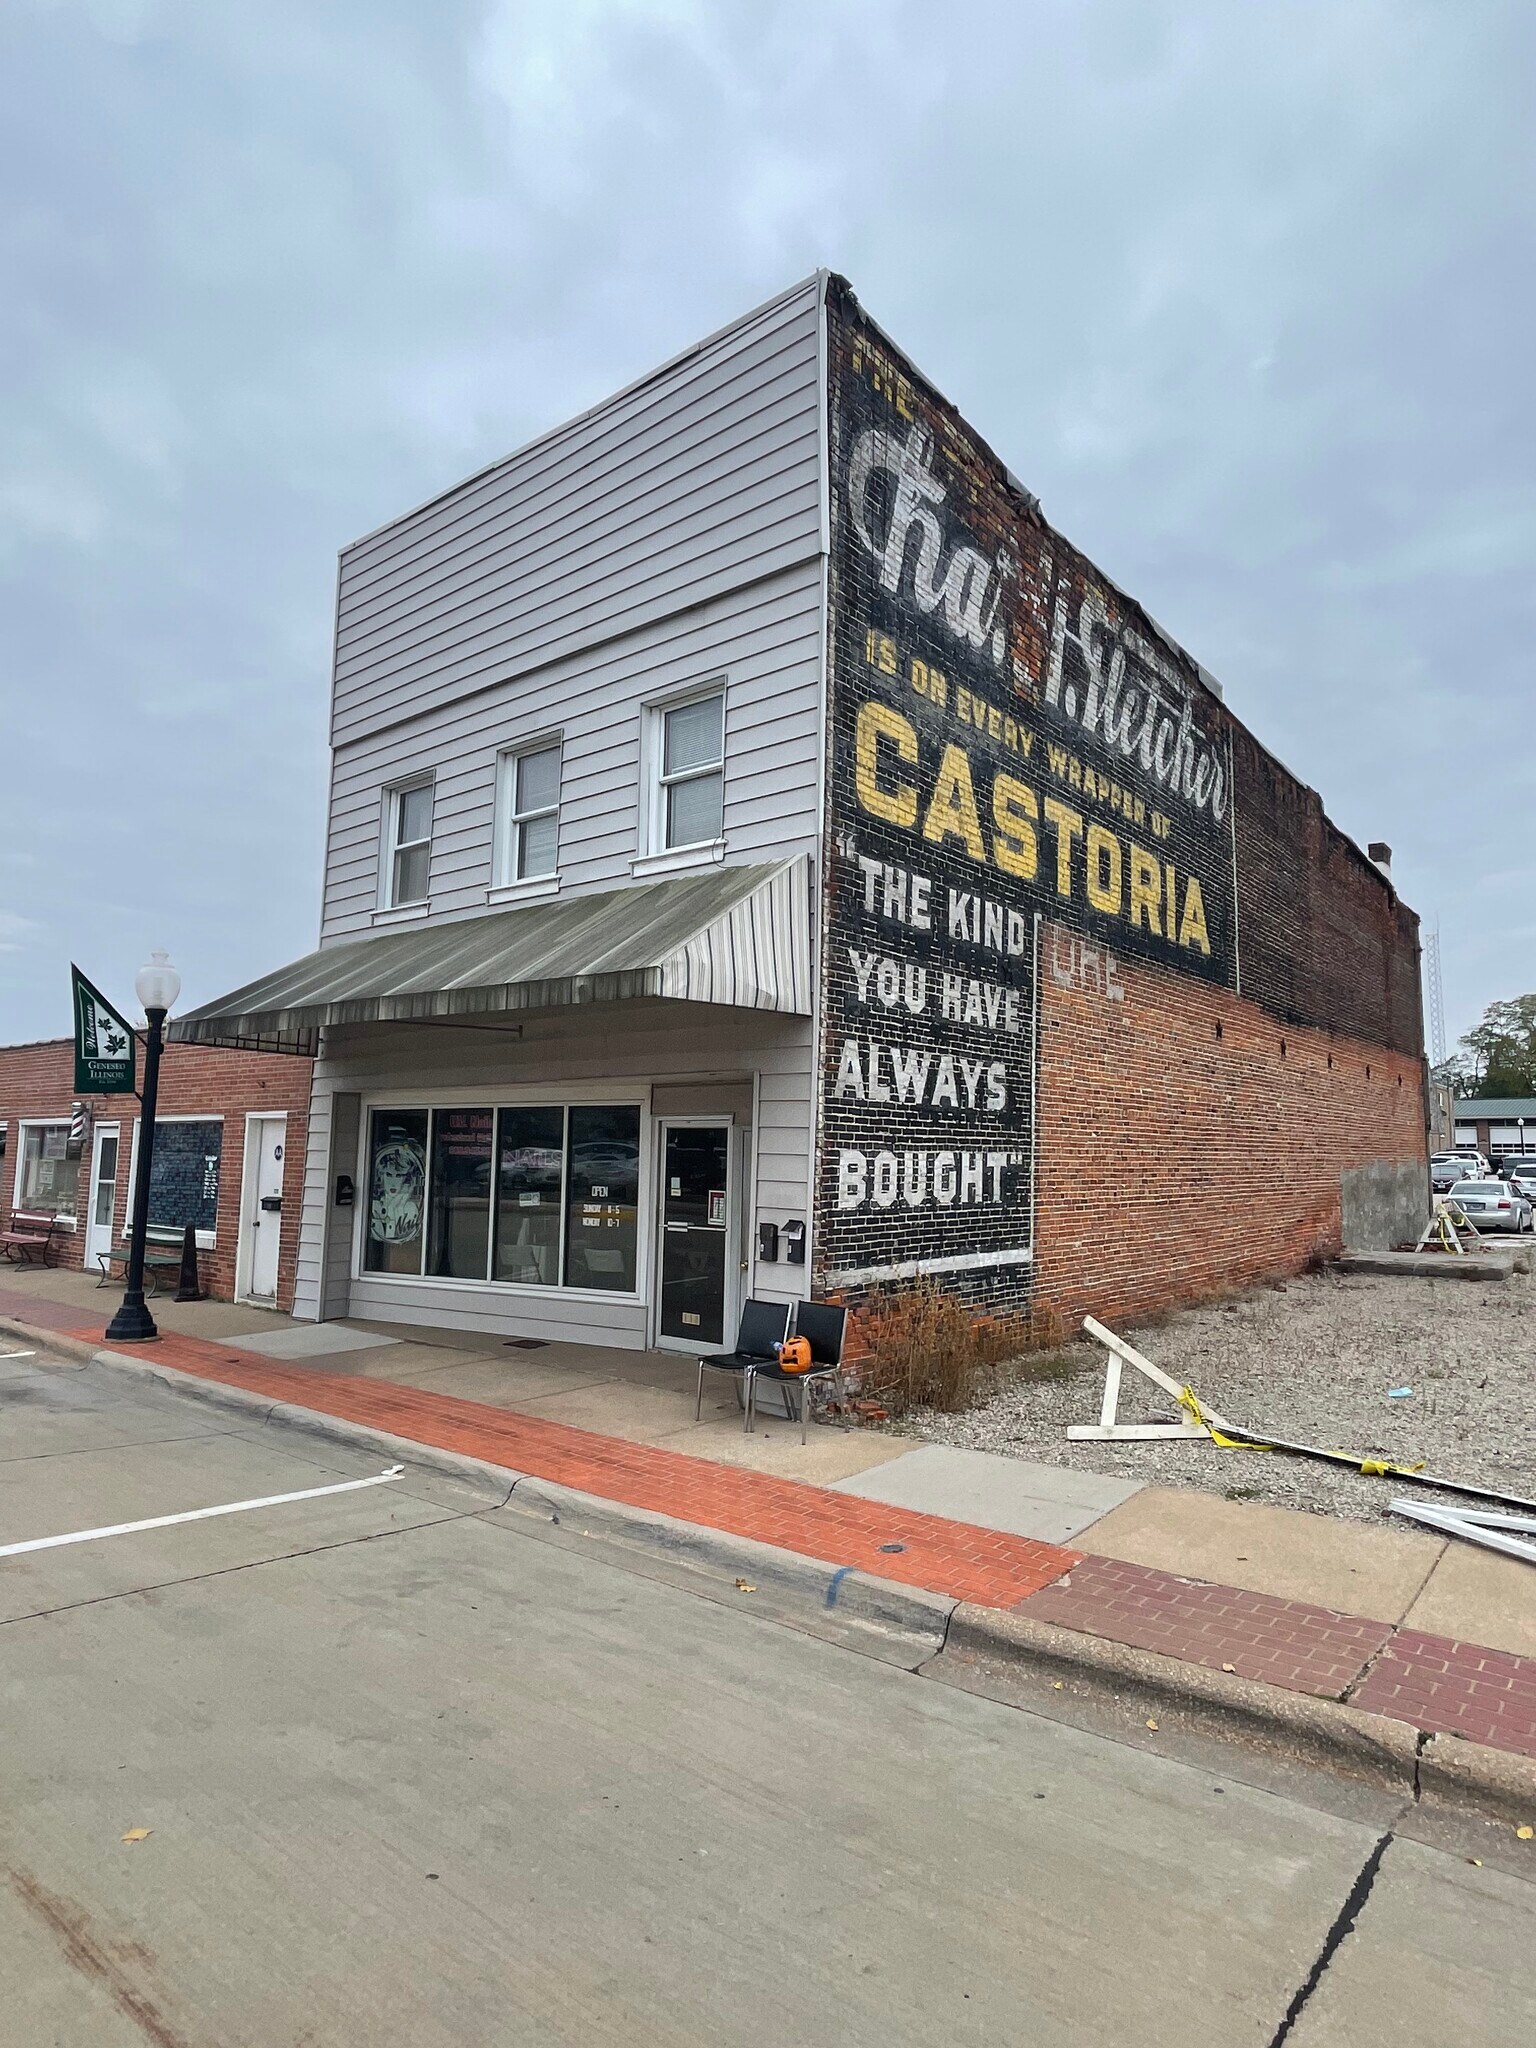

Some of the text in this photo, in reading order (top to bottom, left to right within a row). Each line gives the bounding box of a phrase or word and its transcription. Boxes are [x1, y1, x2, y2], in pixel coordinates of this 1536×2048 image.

[866, 628, 1171, 840] IS ON EVERY WRAPPER OF
[855, 702, 1212, 956] CASTORIA
[948, 888, 1025, 956] KIND
[848, 948, 1020, 1034] YOU HAVE
[834, 1038, 1007, 1111] ALWAYS
